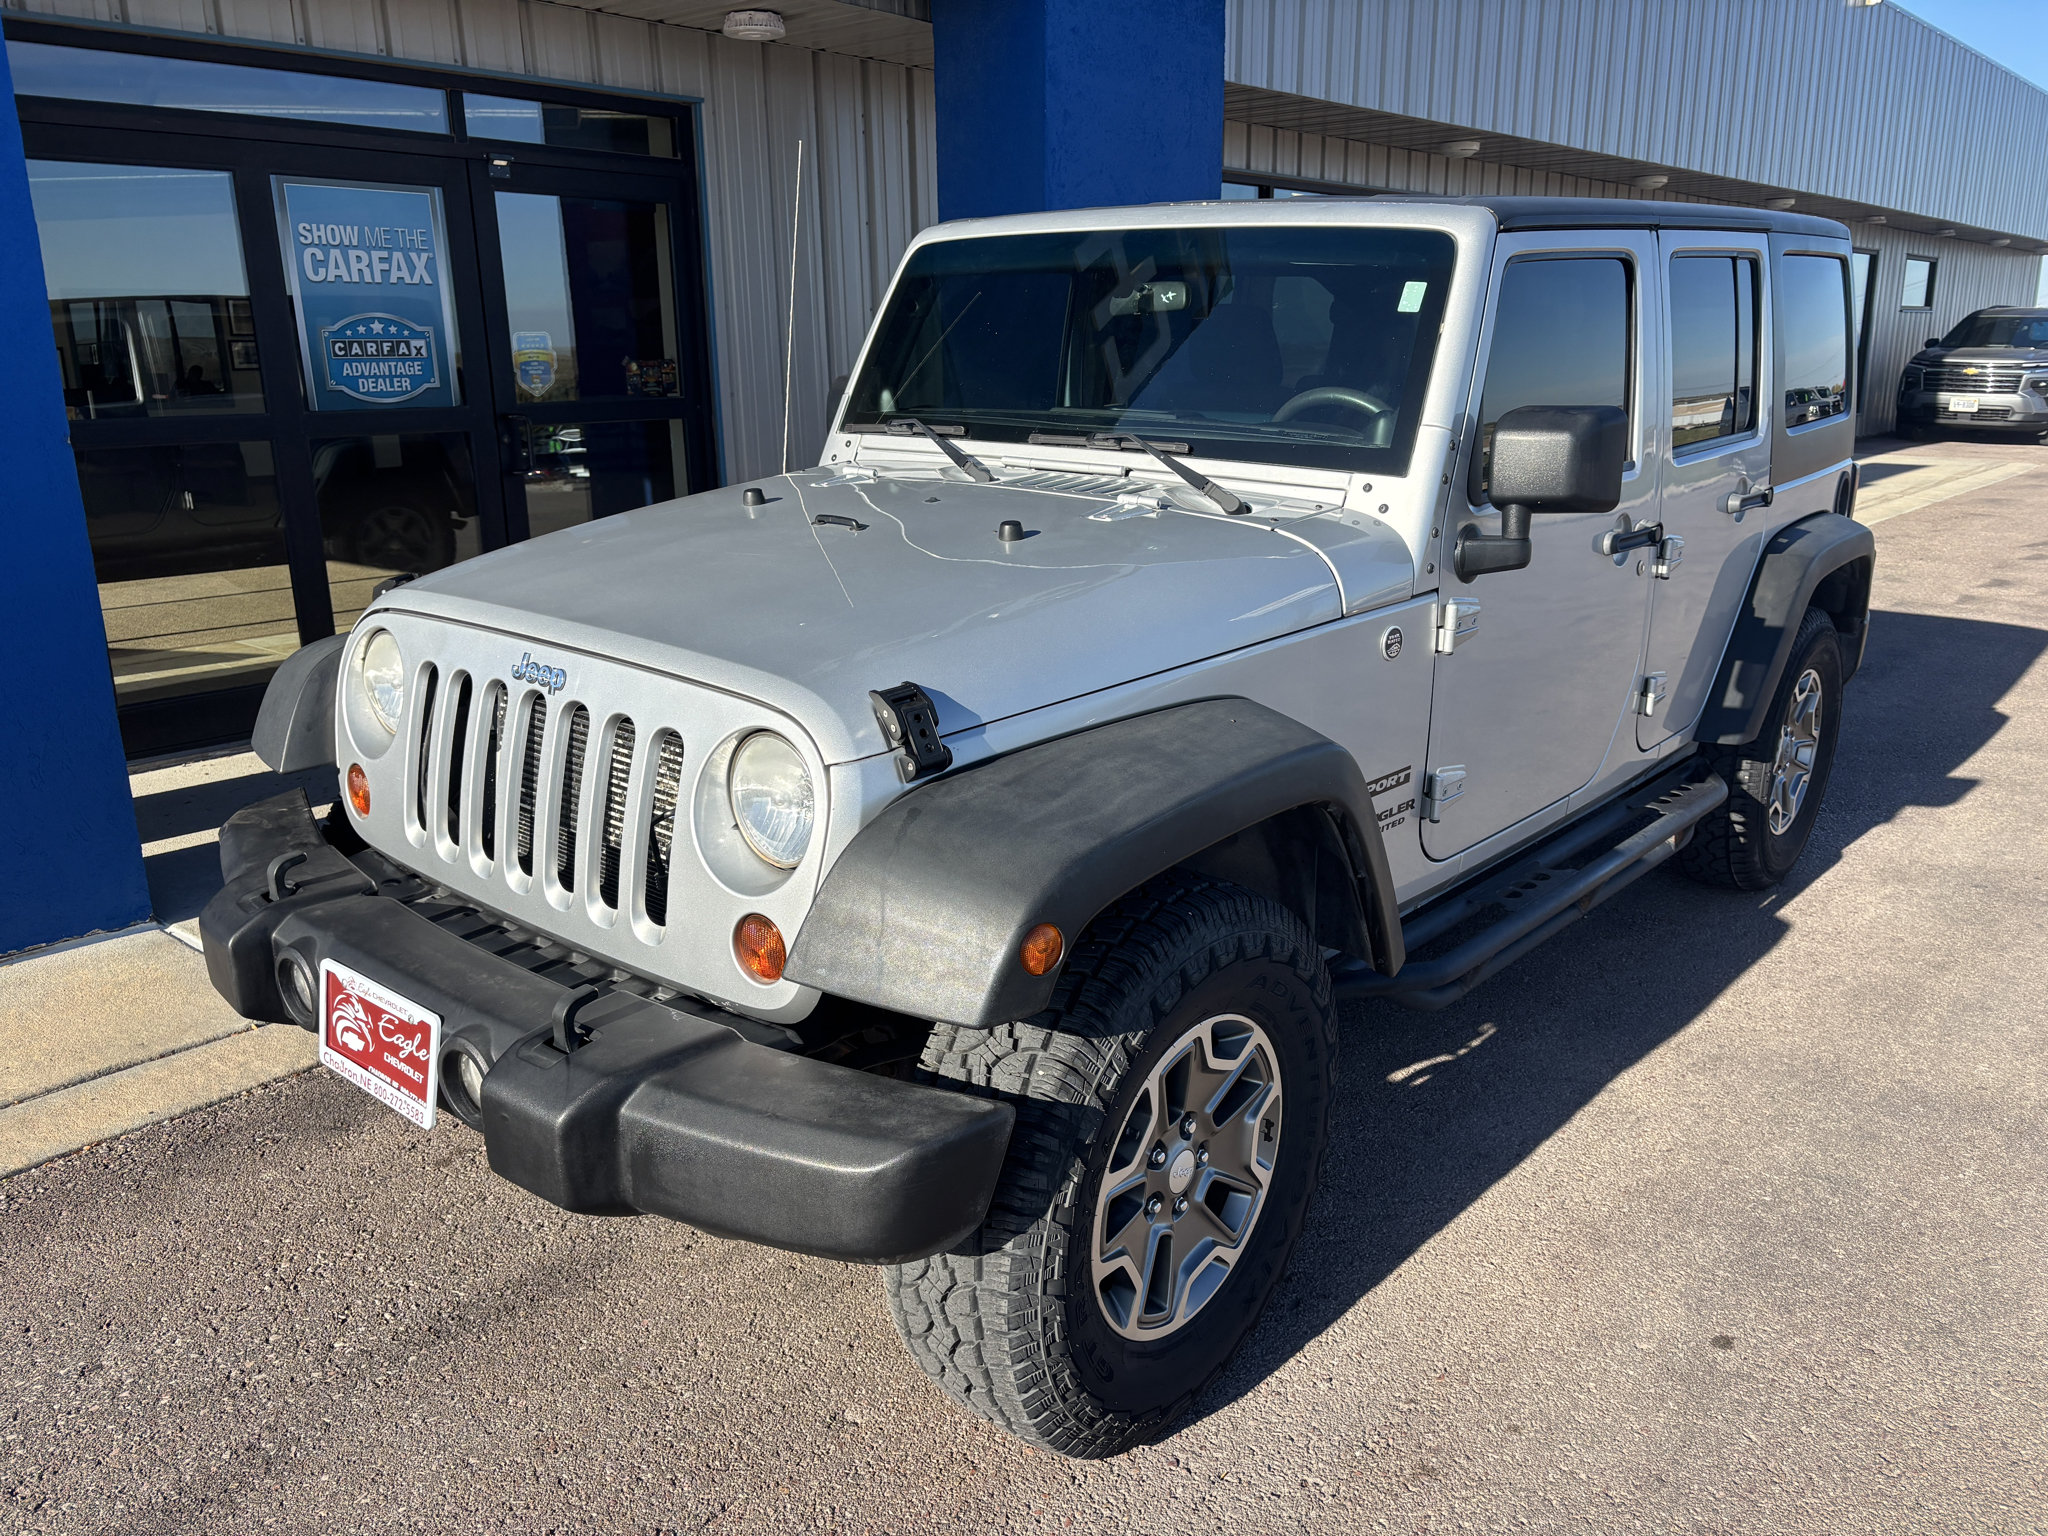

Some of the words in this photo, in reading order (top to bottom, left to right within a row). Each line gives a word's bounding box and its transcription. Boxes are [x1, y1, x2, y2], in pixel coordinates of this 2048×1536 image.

[298, 223, 358, 246] SHOW
[364, 226, 392, 248] ME
[394, 228, 428, 249] THE
[303, 247, 433, 285] CARFAX
[334, 341, 425, 357] CARFAX
[343, 361, 424, 377] ADVANTAGE
[358, 377, 411, 392] DEALER
[511, 652, 567, 696] Jeep
[1367, 773, 1409, 793] PORT
[1376, 798, 1416, 822] GLER
[372, 992, 408, 1016] CHEVROLET
[377, 1013, 430, 1061] Eagle
[384, 1052, 425, 1084] CHEVROLET
[374, 1082, 424, 1124] 800-272-5583
